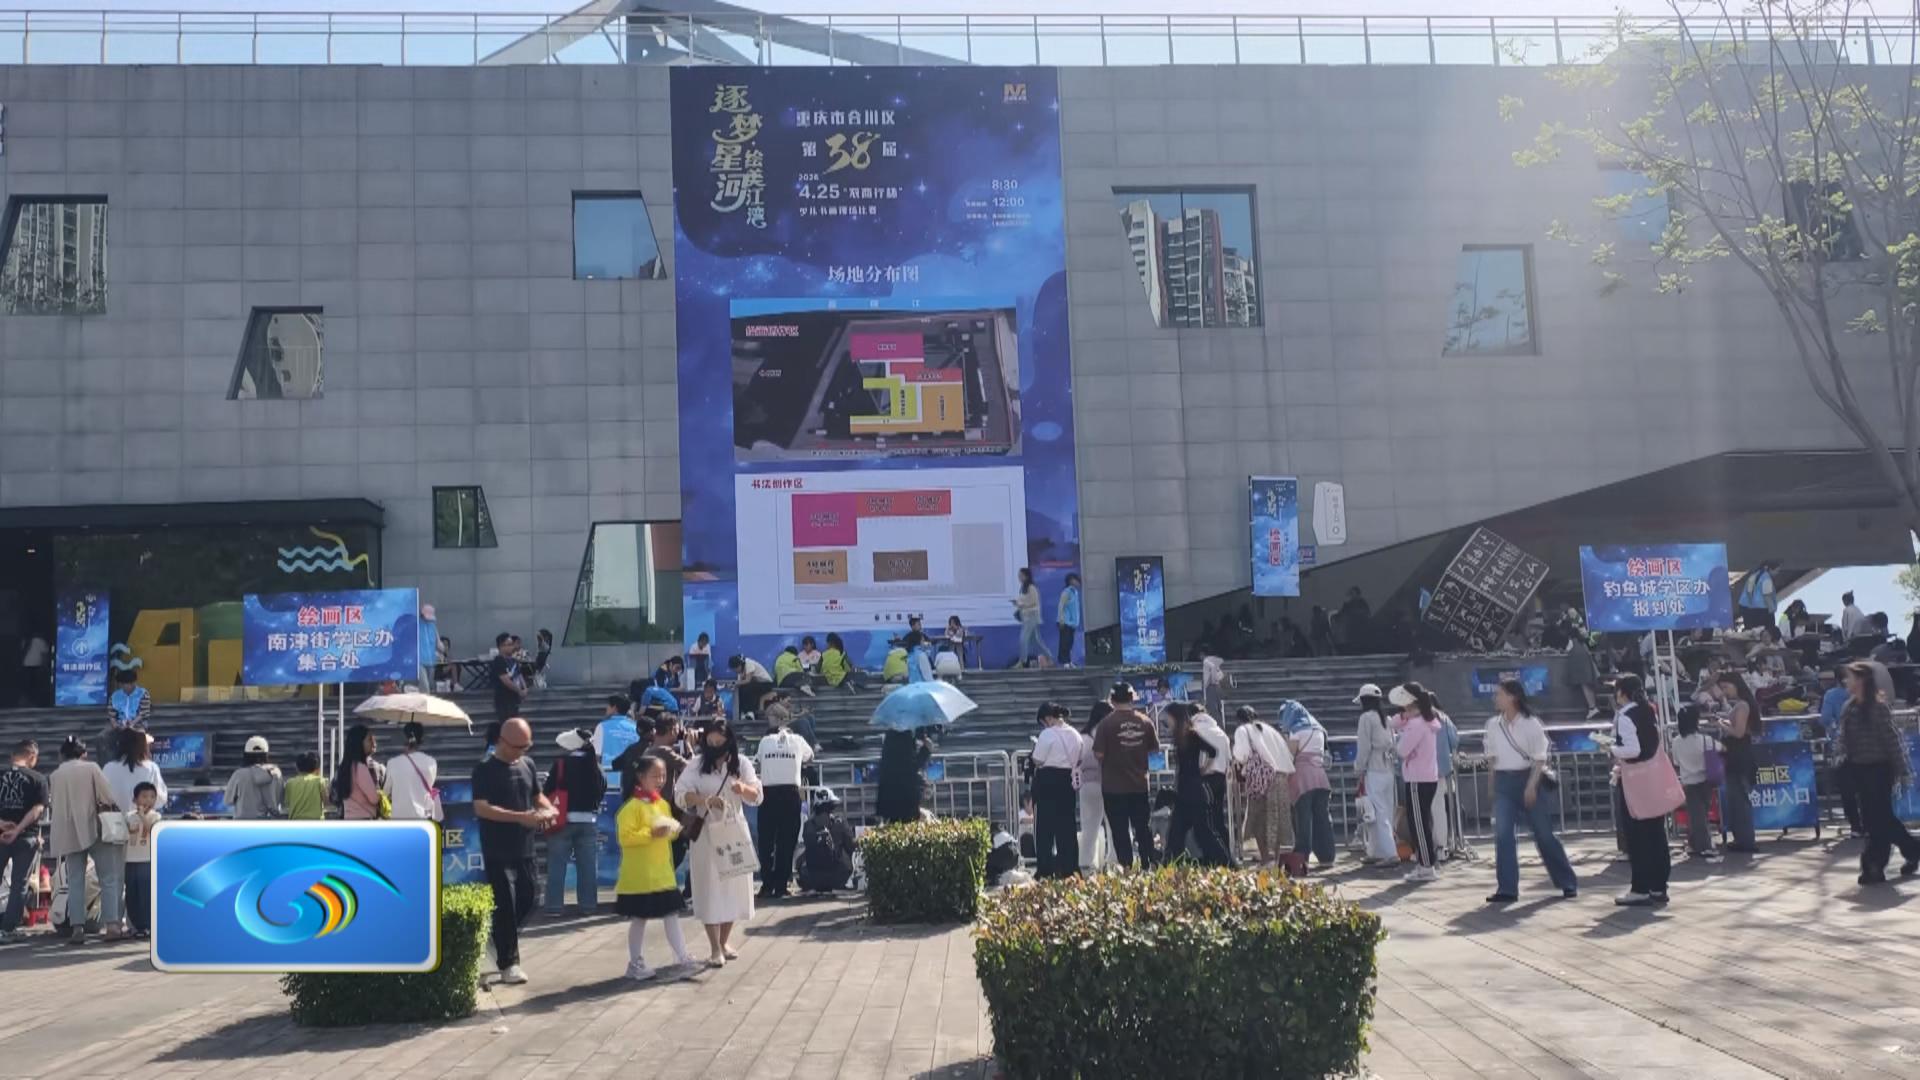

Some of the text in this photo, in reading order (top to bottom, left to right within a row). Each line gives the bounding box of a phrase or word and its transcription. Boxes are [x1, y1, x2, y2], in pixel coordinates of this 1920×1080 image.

[796, 110, 895, 127] 重庆市合川区
[709, 84, 763, 213] 逐梦星河
[799, 184, 840, 199] 4.25
[992, 179, 1018, 191] 8:30
[992, 197, 1025, 208] 12:00
[828, 265, 919, 283] 场地分布图
[1627, 557, 1681, 576] 绘画区
[1604, 580, 1711, 597] 钓鱼城学区办
[298, 605, 364, 626] 绘画区
[1633, 600, 1685, 616] 报到处
[268, 629, 394, 651] 南津街学区办
[298, 651, 360, 671] 集合处
[442, 853, 485, 873] 入口
